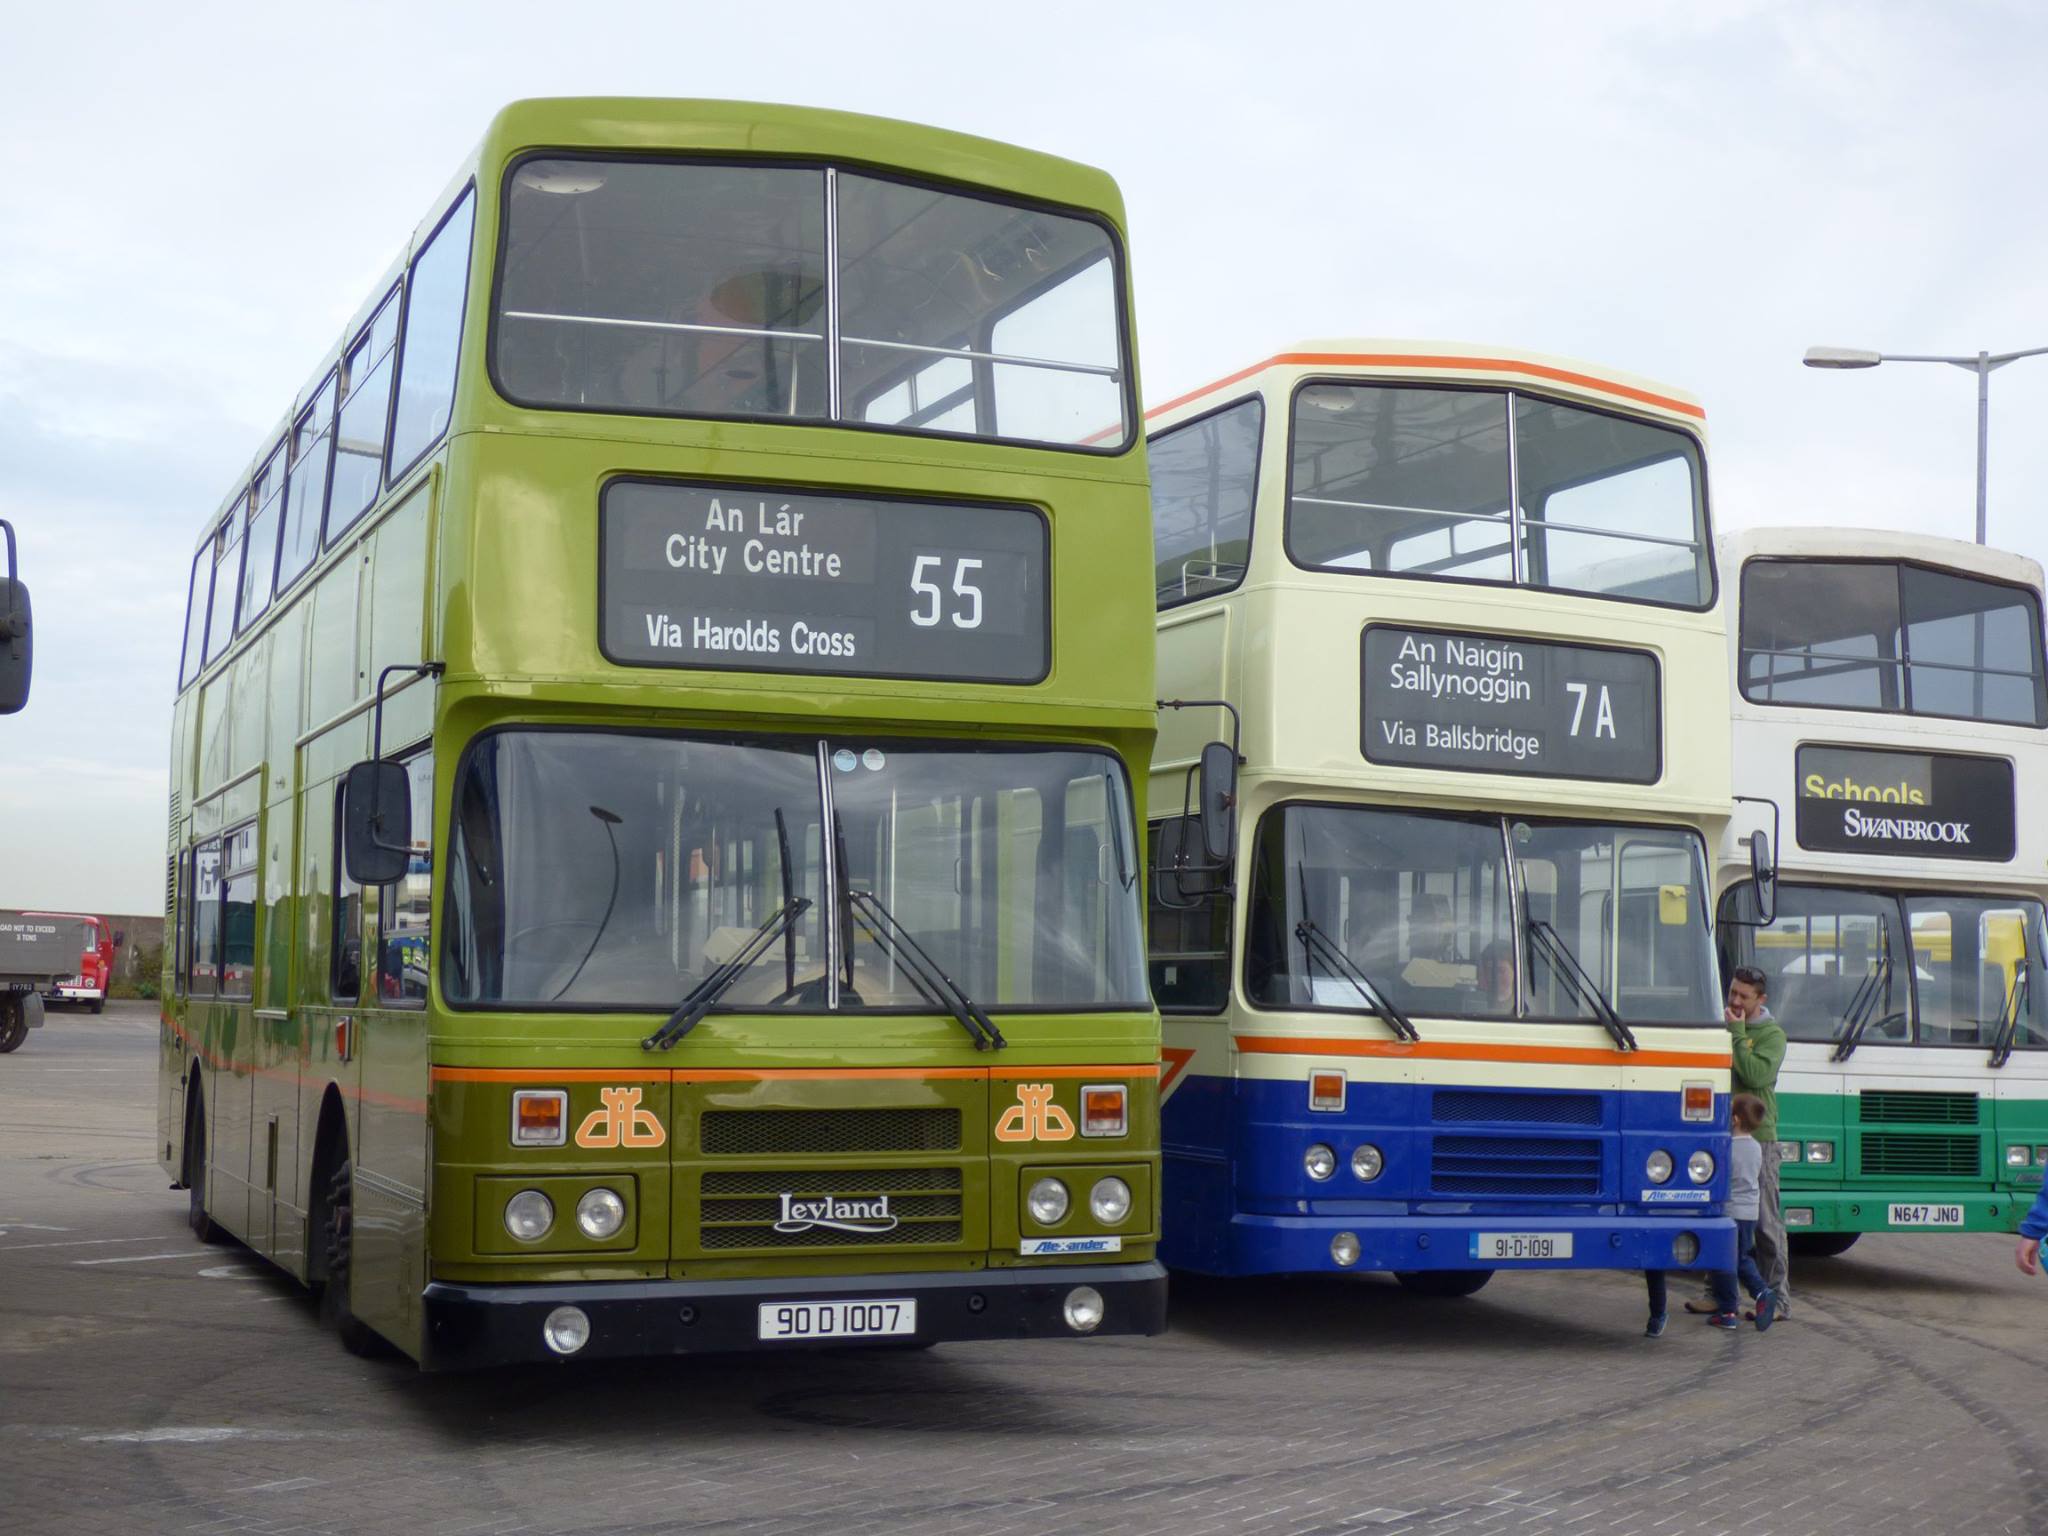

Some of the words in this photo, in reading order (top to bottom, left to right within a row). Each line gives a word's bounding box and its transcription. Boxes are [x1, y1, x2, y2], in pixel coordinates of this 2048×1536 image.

[705, 498, 743, 533] An
[759, 502, 804, 537] Lár
[665, 533, 727, 575] City
[743, 539, 841, 578] Centre
[910, 555, 983, 629] 55
[646, 614, 682, 648] Via
[693, 617, 780, 654] Harolds
[791, 622, 856, 657] Cross
[1399, 635, 1435, 662] An
[1446, 639, 1523, 676] Naigín
[1390, 664, 1531, 703] Sallynoggin
[1566, 683, 1616, 739] 7A
[1382, 720, 1416, 747] Via
[1426, 724, 1540, 760] Ballsbridge
[1805, 774, 1925, 806] Schools
[776, 1193, 896, 1230] Leyland
[1894, 1207, 1928, 1222] N647
[1496, 1239, 1553, 1257] 91-D-1091
